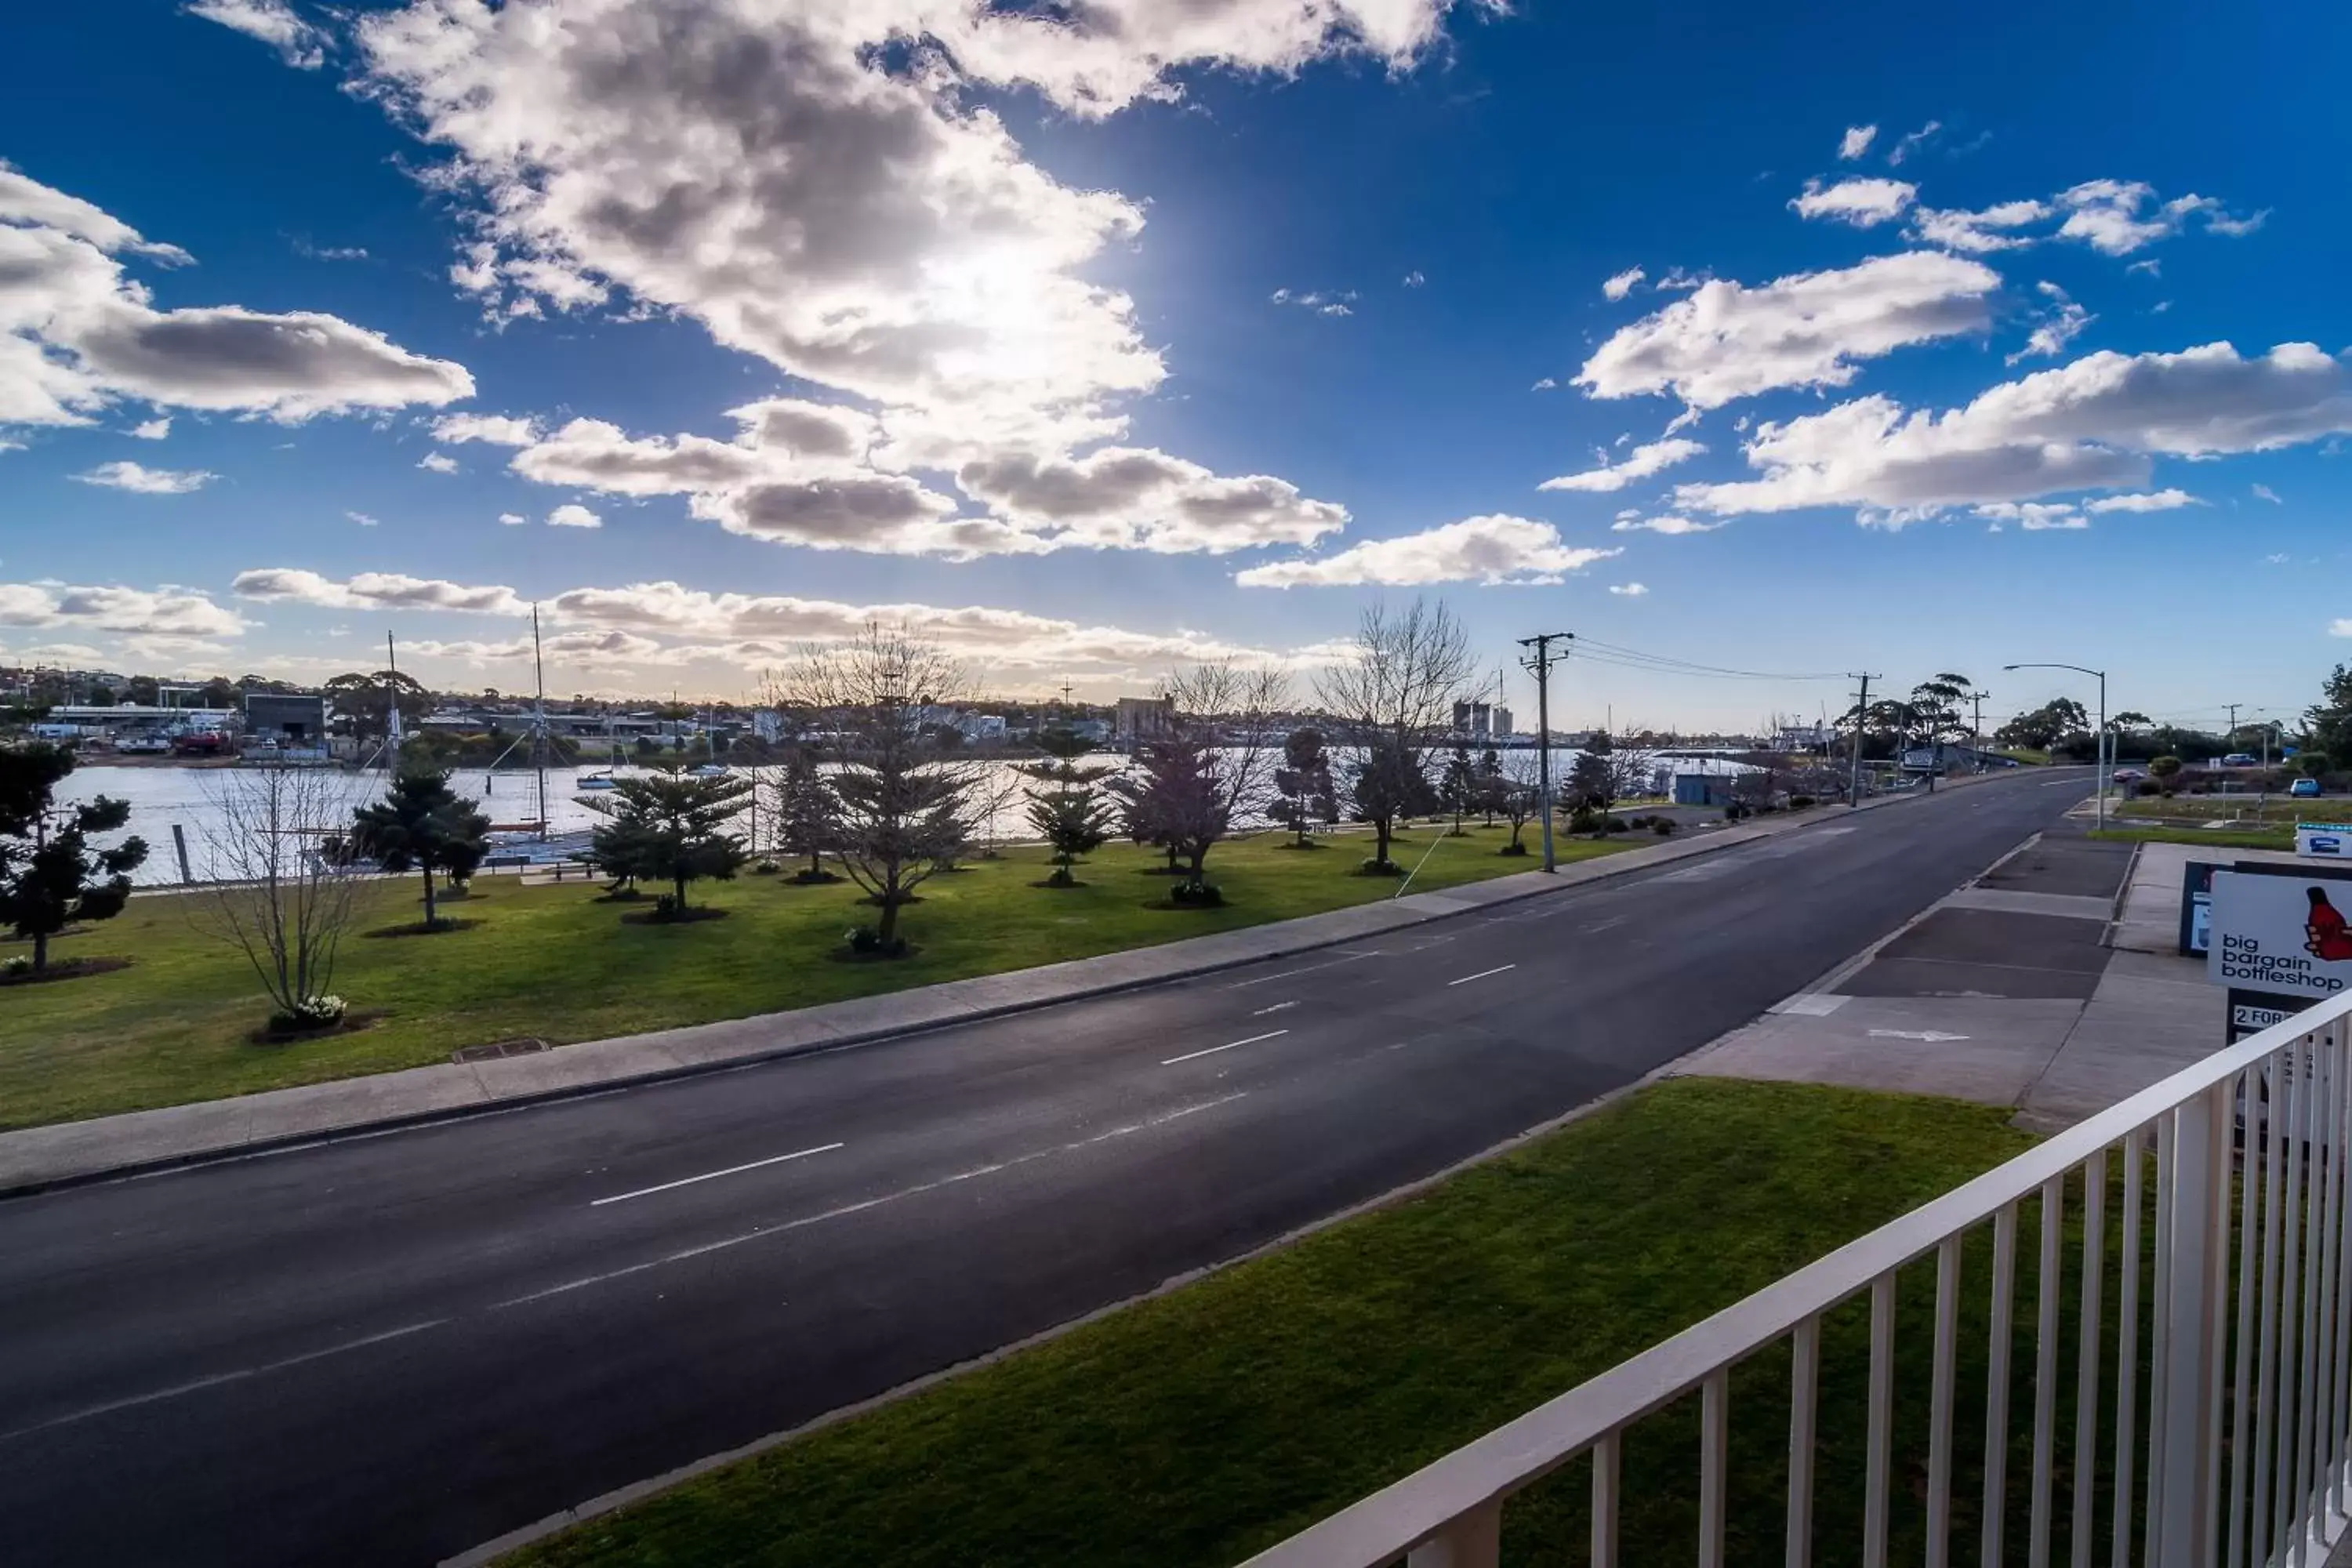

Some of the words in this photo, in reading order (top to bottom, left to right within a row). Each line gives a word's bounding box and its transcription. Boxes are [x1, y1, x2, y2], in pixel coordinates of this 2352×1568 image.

[2223, 933, 2259, 953] big
[2222, 948, 2311, 971] bargain
[2222, 963, 2343, 991] bottleshop
[2236, 1008, 2247, 1023] 2
[2252, 1010, 2283, 1024] FOR
